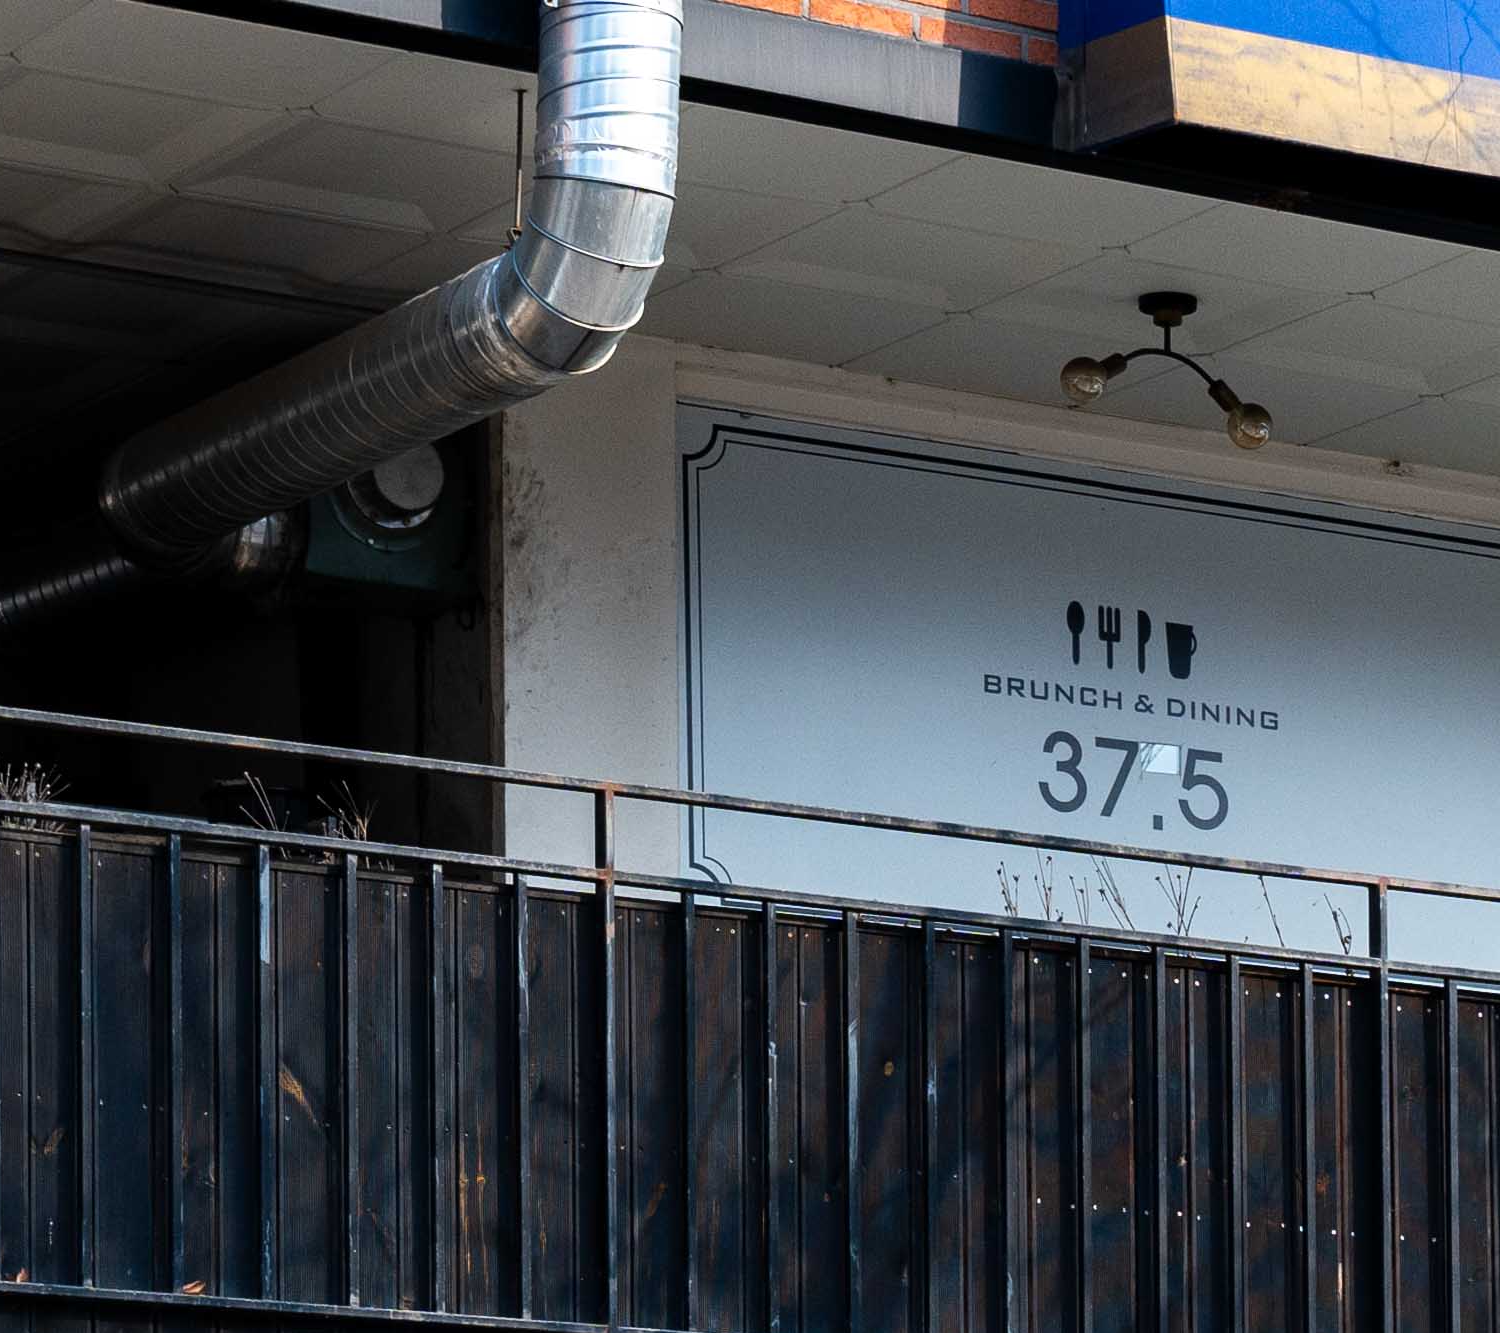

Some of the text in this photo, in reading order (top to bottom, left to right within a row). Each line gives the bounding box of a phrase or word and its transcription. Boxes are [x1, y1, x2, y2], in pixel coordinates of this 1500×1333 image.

[982, 673, 1280, 731] BRUNCH & DINING
[1037, 730, 1229, 830] 37.5
